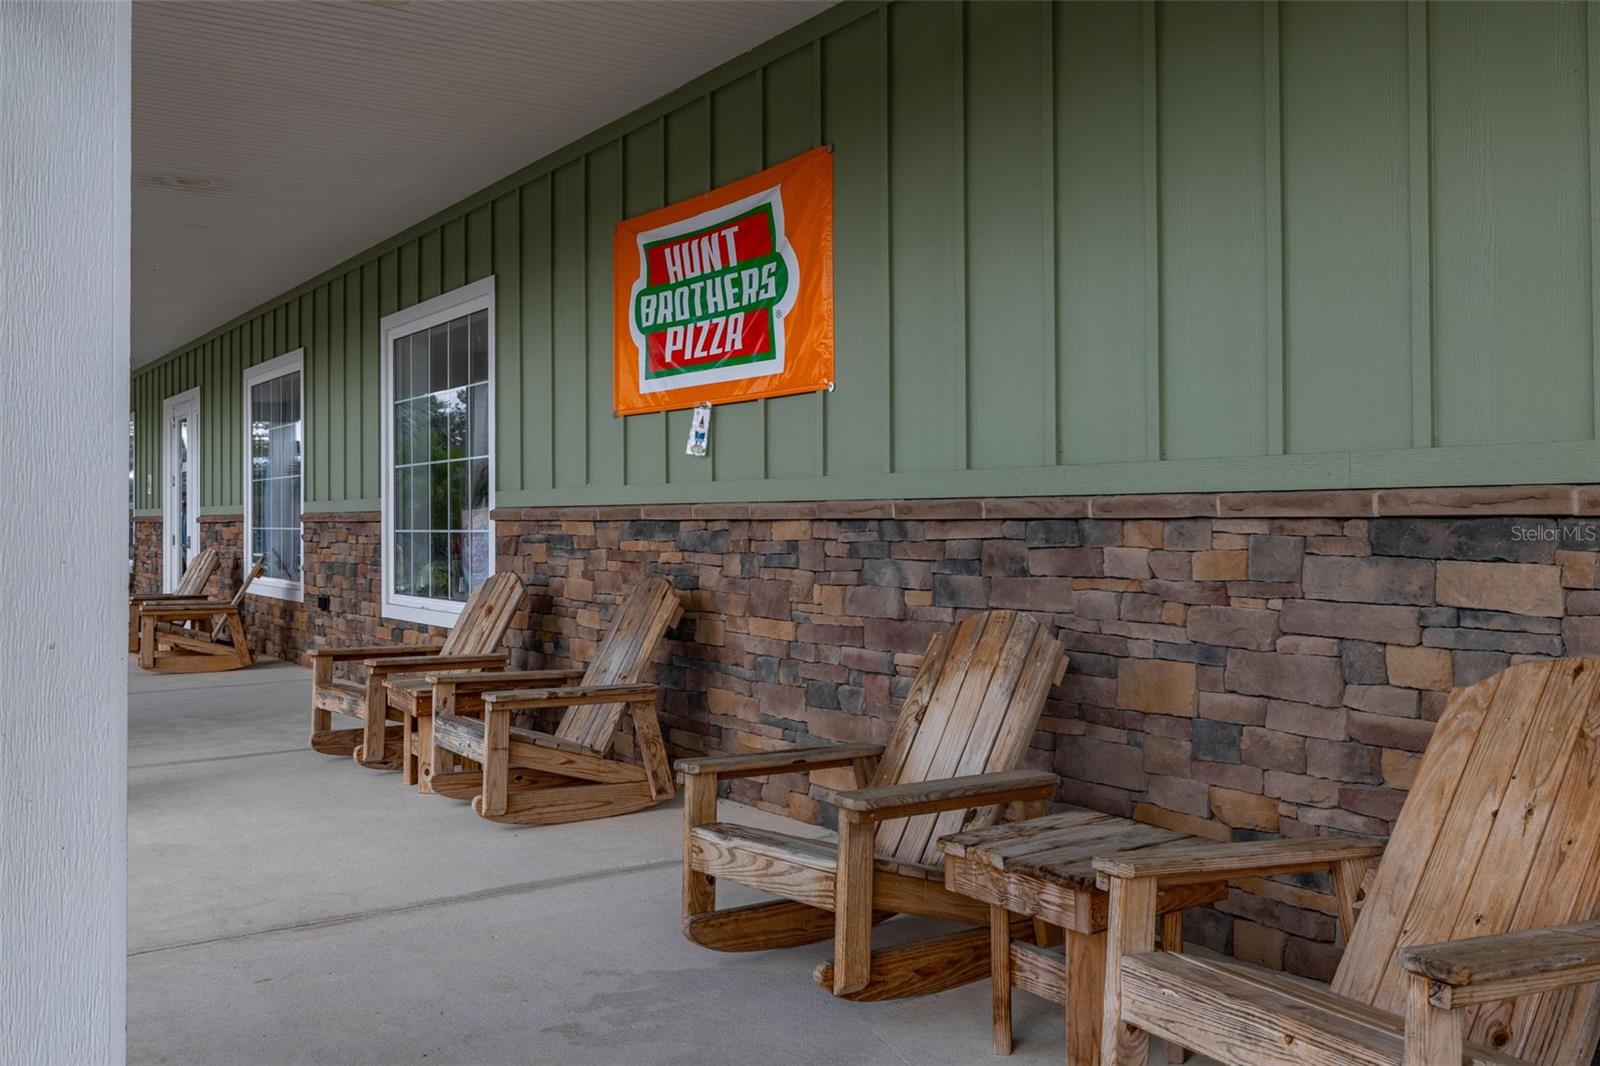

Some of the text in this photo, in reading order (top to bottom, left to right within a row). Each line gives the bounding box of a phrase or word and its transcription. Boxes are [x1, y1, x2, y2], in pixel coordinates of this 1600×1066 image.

[664, 225, 740, 285] HUNT
[640, 261, 777, 328] BROTHERS
[664, 312, 745, 363] PIZZA
